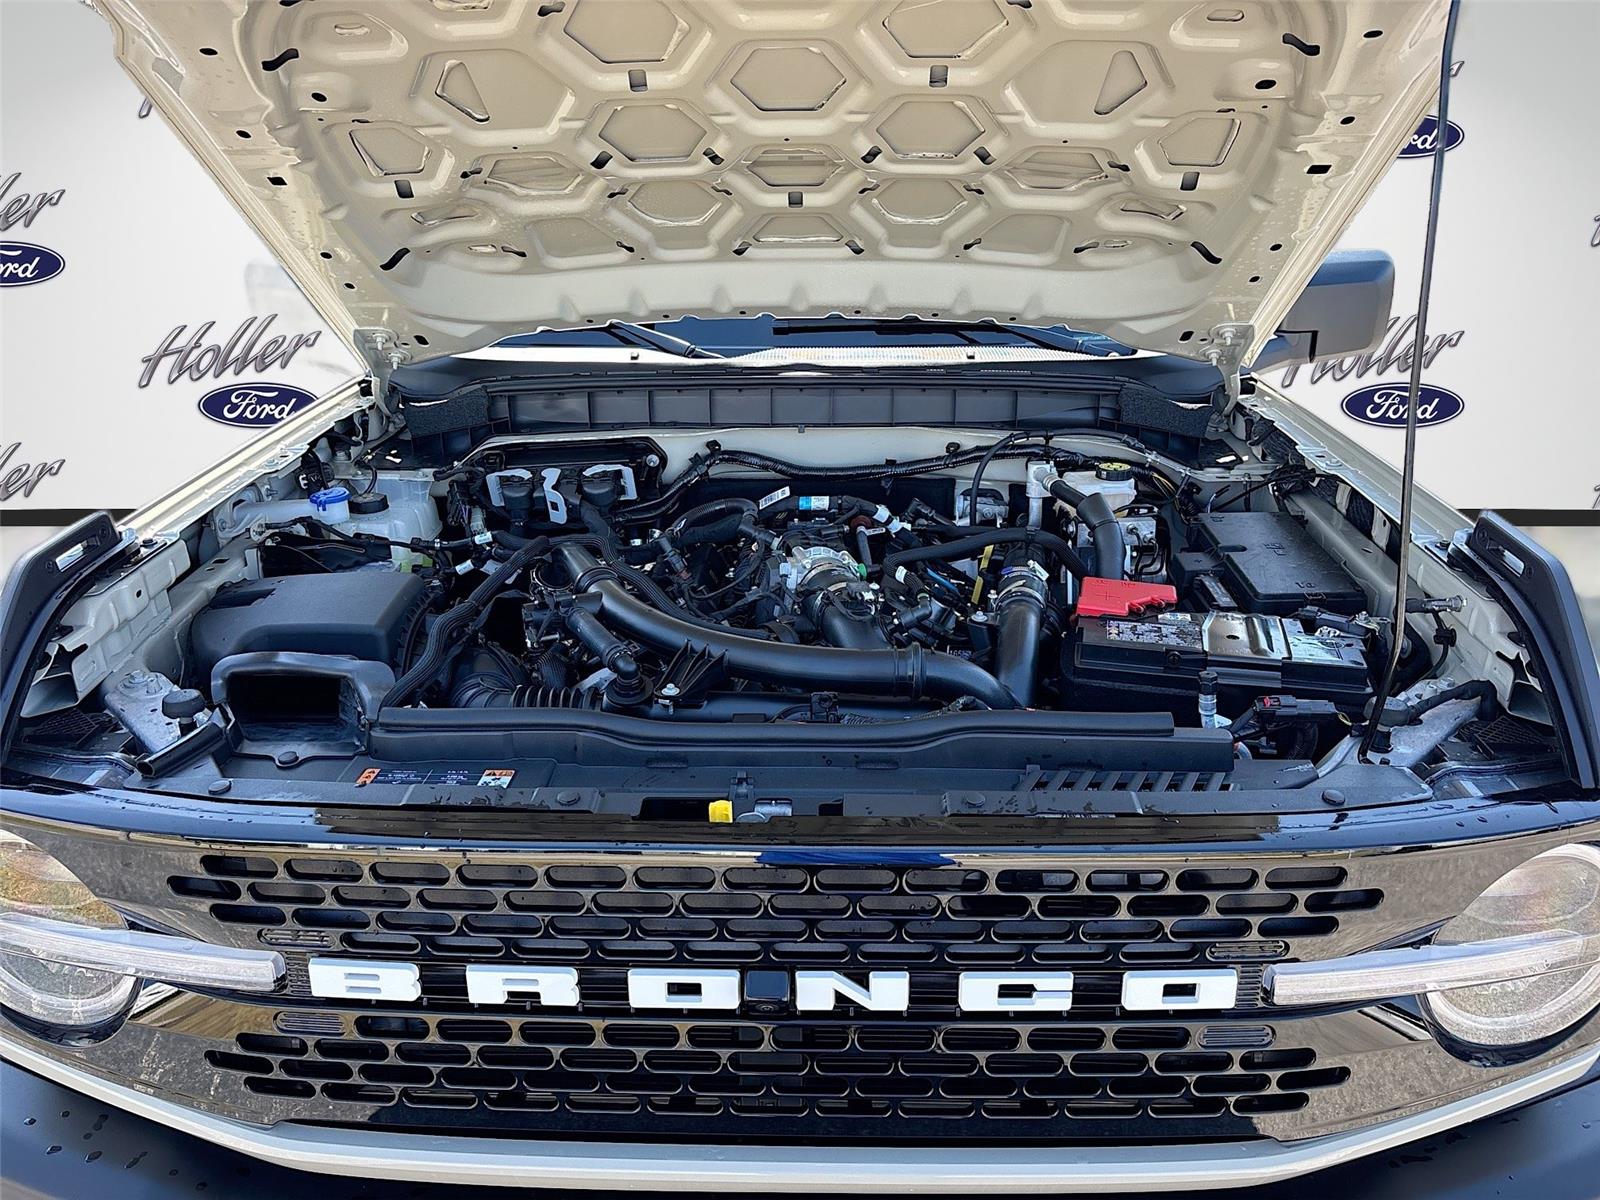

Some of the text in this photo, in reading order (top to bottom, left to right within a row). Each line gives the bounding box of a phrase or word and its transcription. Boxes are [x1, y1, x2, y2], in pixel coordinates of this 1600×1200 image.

[138, 313, 322, 388] Holler
[223, 389, 298, 420] Ford
[308, 957, 1238, 1011] BRONCO
